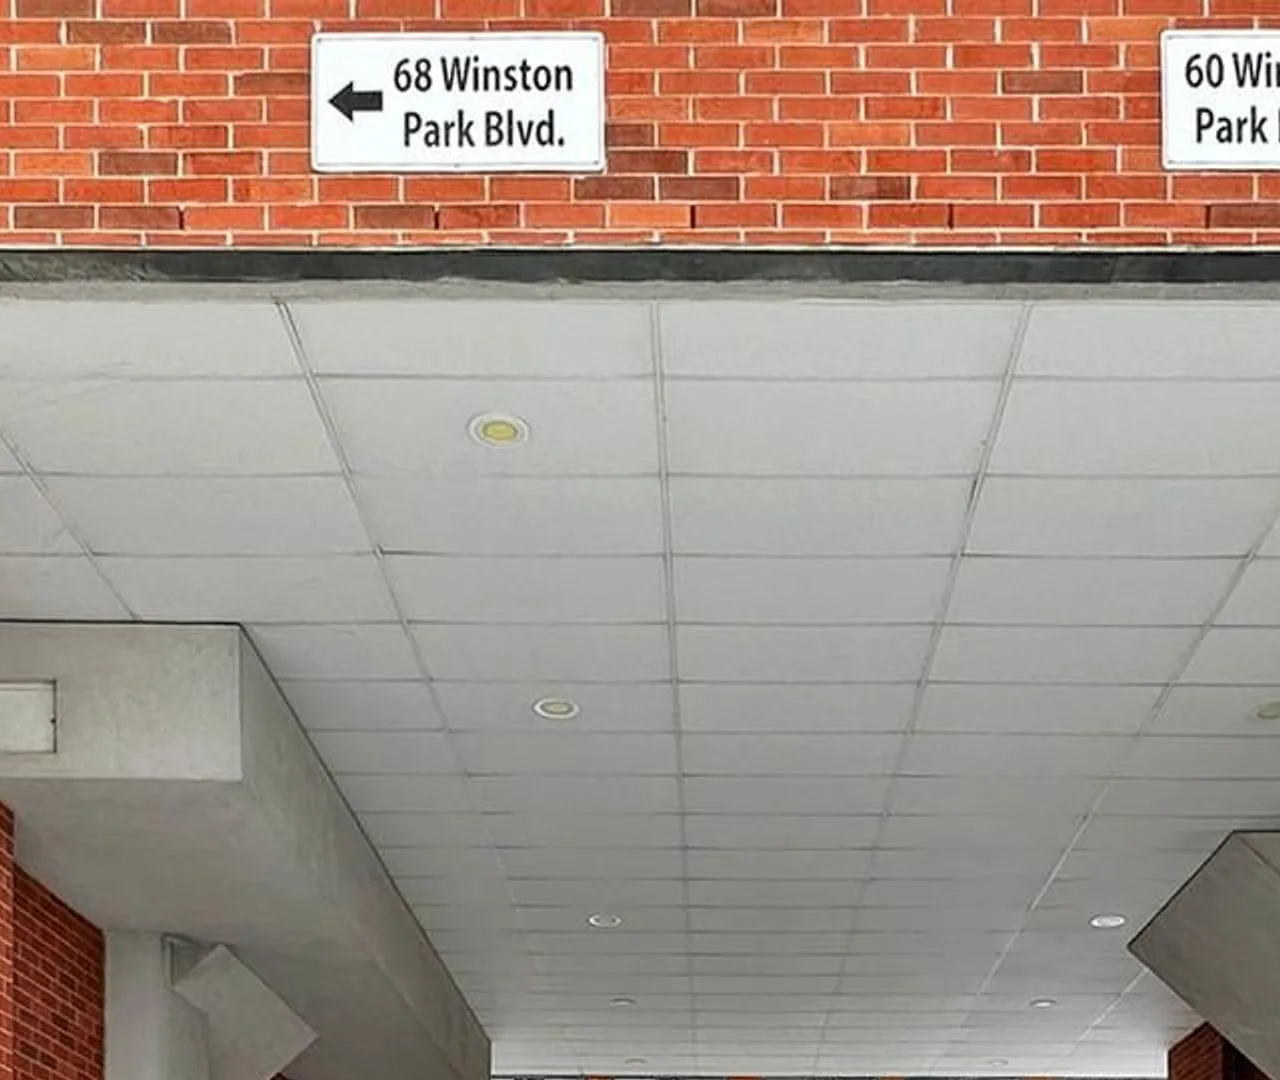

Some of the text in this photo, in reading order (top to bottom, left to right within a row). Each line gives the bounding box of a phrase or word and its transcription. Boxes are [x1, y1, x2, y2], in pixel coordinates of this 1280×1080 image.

[393, 55, 574, 93] 68 Winston
[1184, 52, 1225, 89] 60
[403, 108, 566, 148] Park Blvd.
[1195, 105, 1269, 144] Park
